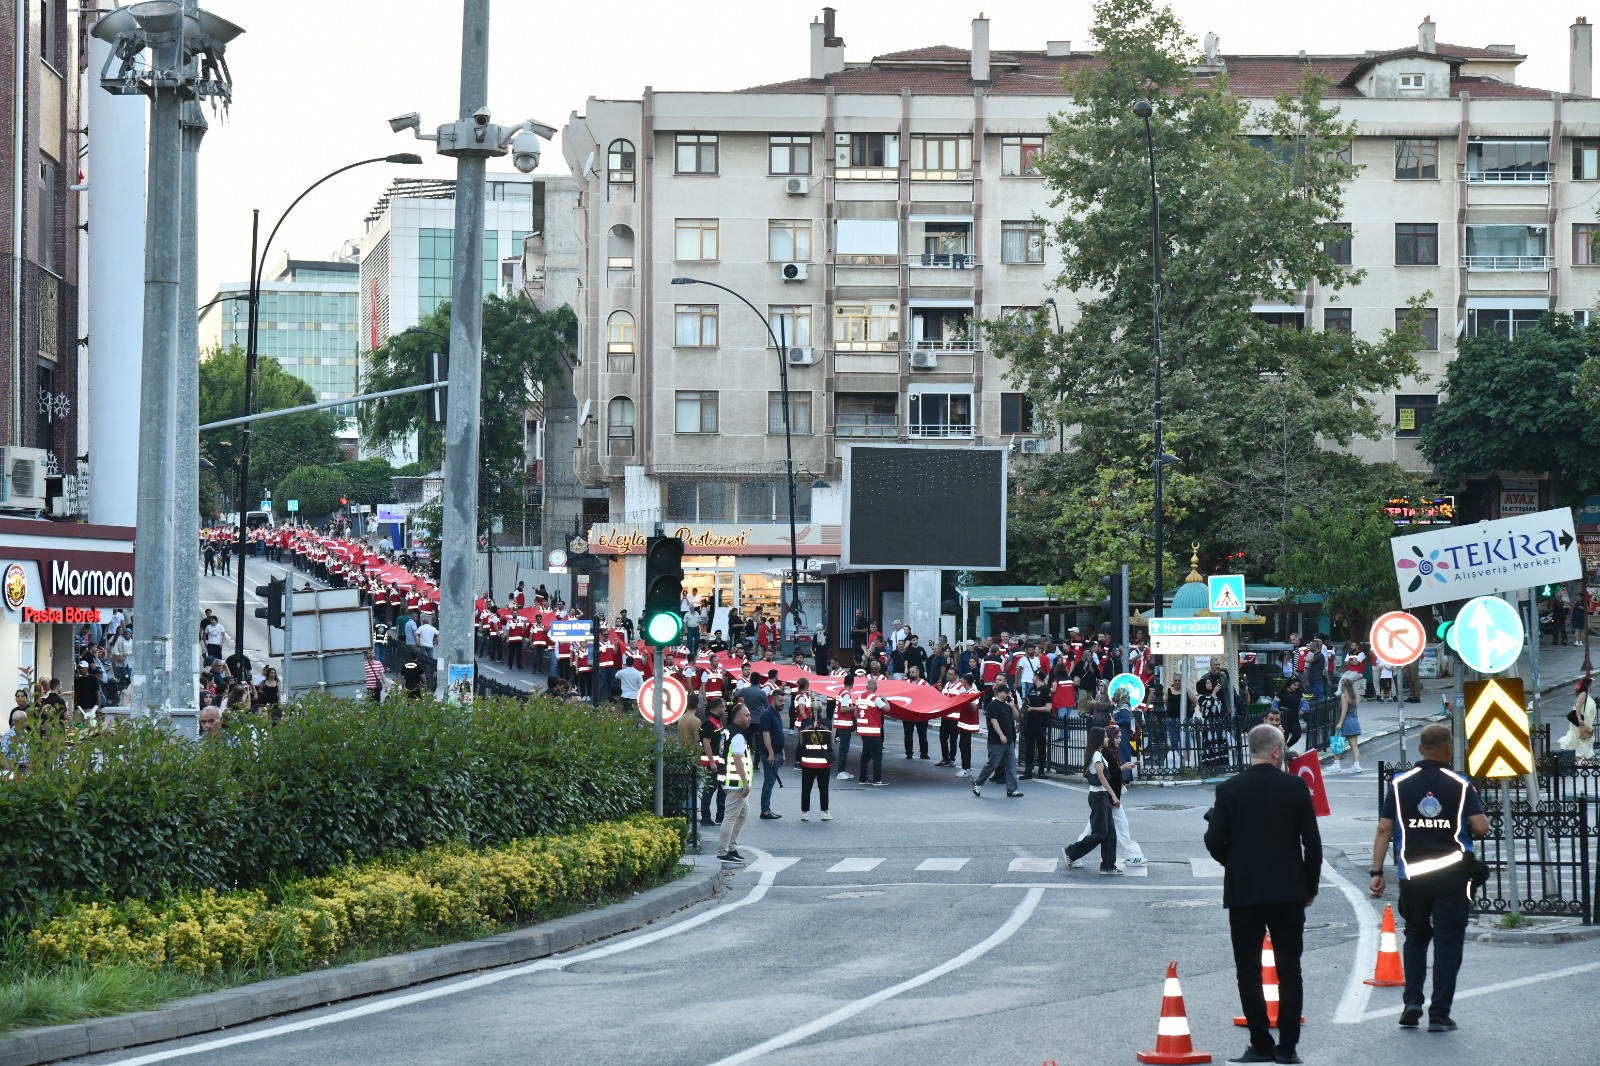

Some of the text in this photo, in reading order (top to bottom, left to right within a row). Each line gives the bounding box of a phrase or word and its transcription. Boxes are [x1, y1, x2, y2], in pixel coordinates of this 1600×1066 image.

[1503, 493, 1535, 505] AYAZ
[675, 527, 747, 547] Pastanesi
[1454, 554, 1561, 581] Alışveriş Merkezi
[52, 560, 133, 596] Marmara
[24, 606, 102, 623] Pasta Börek
[1162, 621, 1218, 634] Hayrabolu
[1408, 818, 1451, 828] ZABITA
